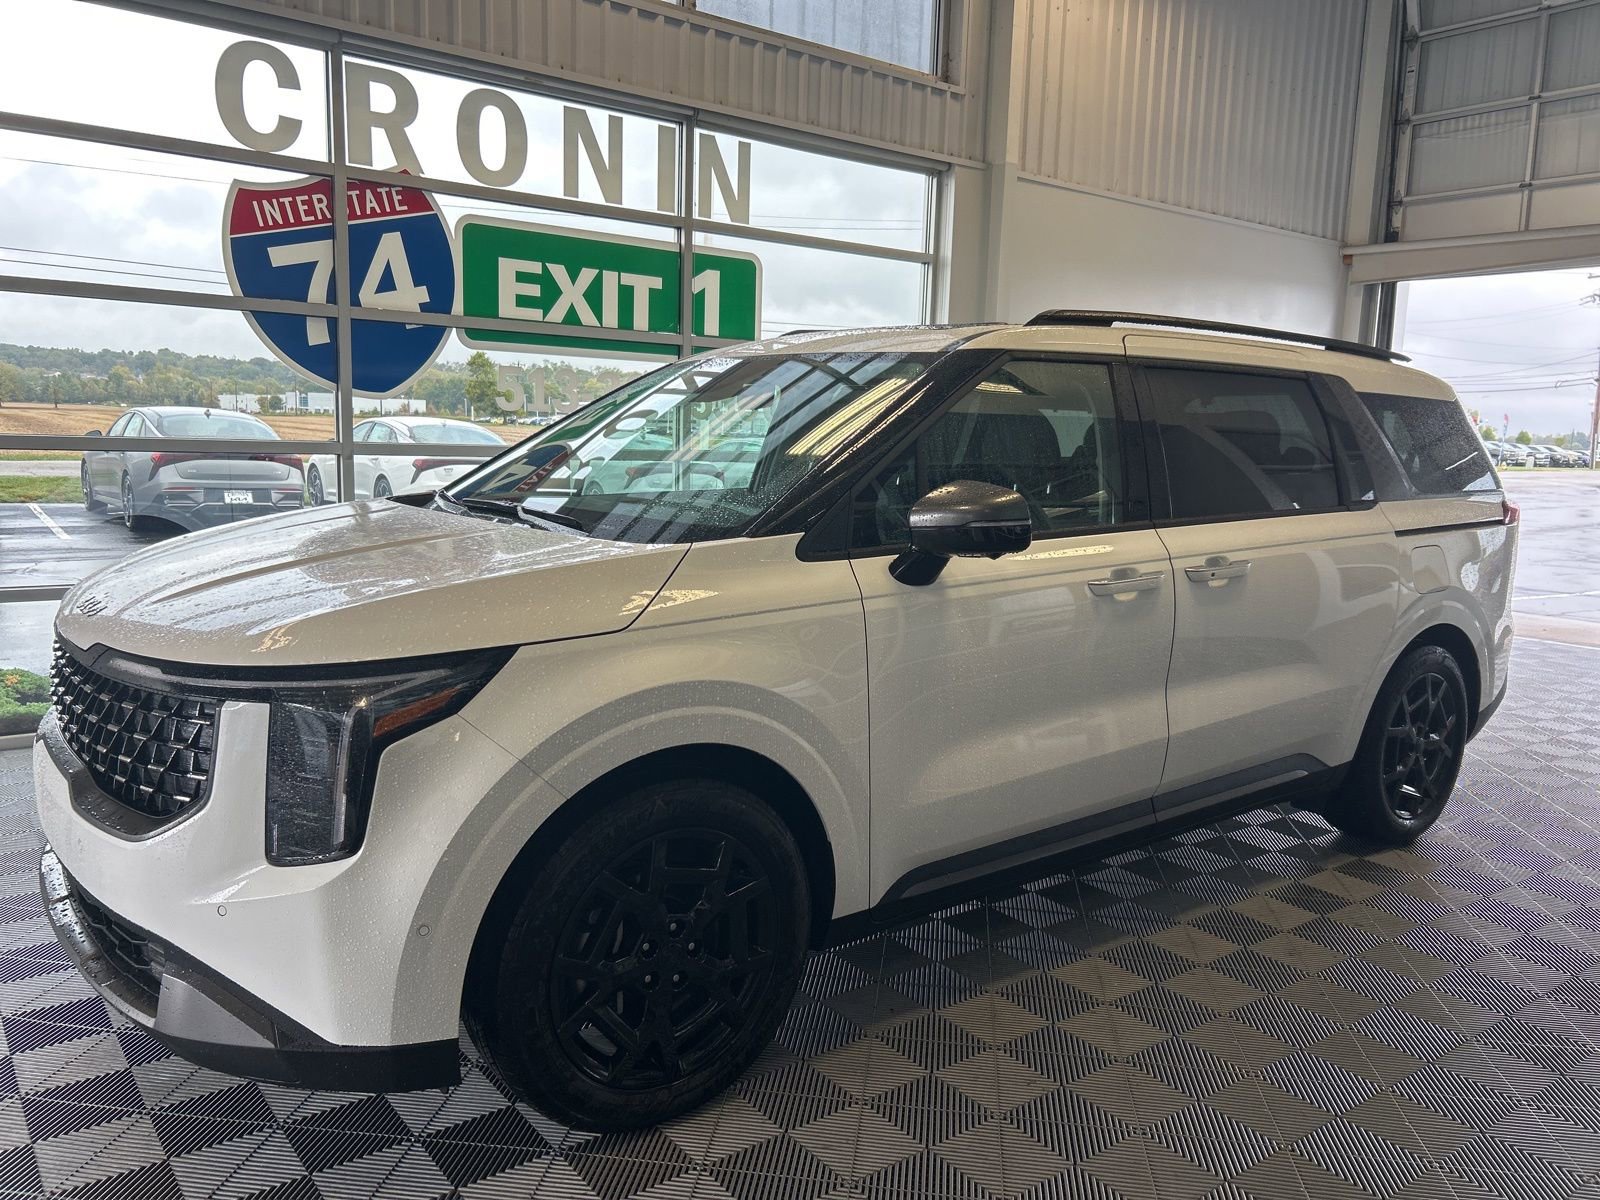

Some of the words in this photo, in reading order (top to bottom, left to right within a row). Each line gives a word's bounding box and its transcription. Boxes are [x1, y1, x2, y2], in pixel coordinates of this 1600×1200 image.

[215, 40, 751, 225] CRONIN
[252, 186, 408, 227] INTERTATE
[267, 232, 430, 346] 74
[498, 257, 663, 332] EXIT
[692, 269, 720, 337] 1
